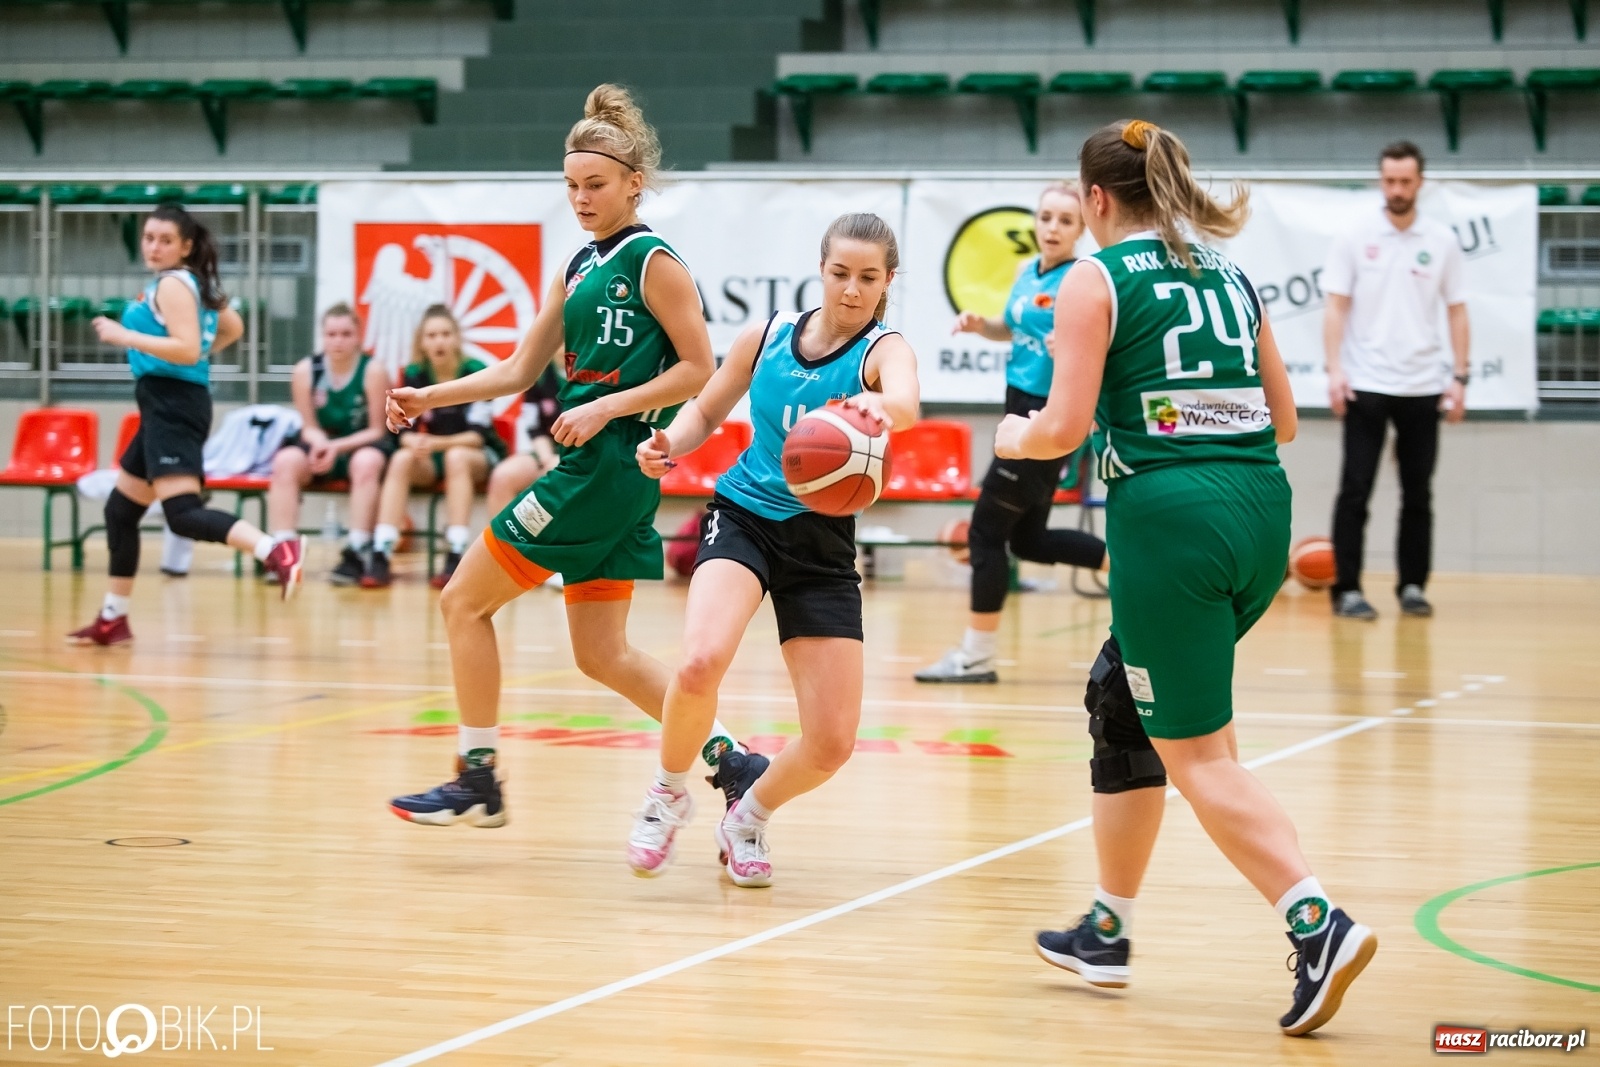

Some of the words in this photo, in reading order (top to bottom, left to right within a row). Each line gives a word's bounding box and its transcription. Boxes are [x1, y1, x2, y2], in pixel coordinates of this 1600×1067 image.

[1121, 250, 1165, 274] RKK
[596, 305, 635, 347] 35
[1152, 281, 1258, 380] 24
